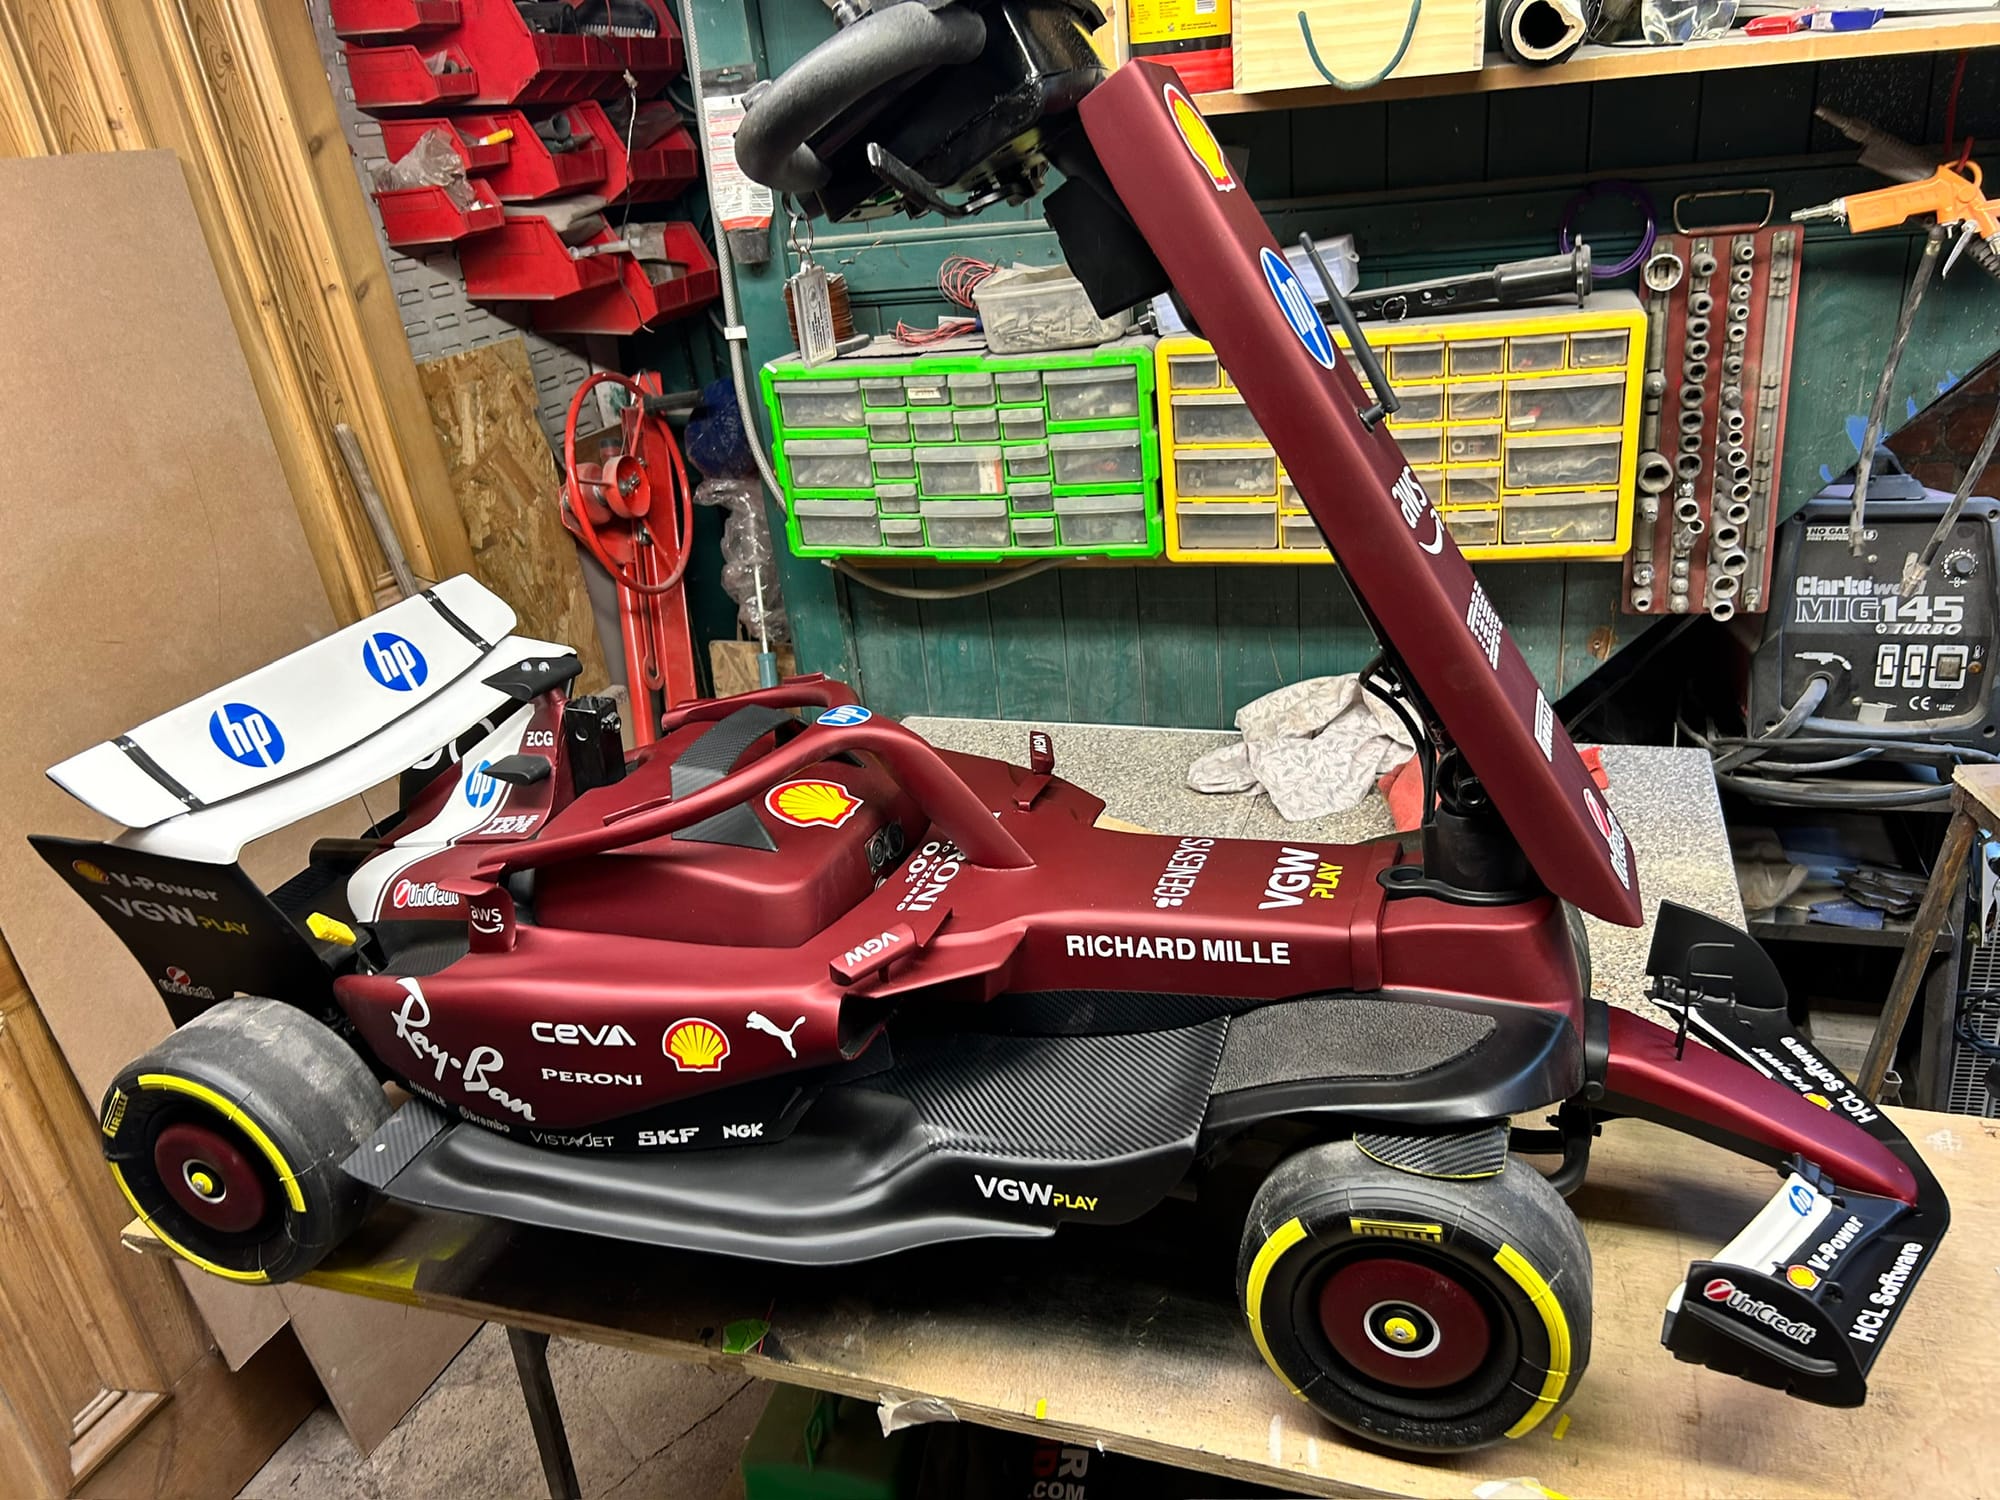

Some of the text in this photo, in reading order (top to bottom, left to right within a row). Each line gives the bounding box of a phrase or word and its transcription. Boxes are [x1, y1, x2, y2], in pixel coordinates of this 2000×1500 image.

[1262, 250, 1331, 366] hp
[1391, 465, 1428, 529] aws
[1828, 527, 1849, 535] GAS
[1796, 576, 1873, 596] Clarke
[1890, 623, 1963, 635] TURBO
[364, 633, 419, 690] hp
[215, 703, 277, 767] hp
[526, 731, 554, 746] ZCG
[1032, 734, 1047, 754] VGW
[469, 765, 492, 808] hp
[479, 815, 539, 835] IBM
[1152, 837, 1216, 899] GENESYS
[1257, 846, 1344, 910] VGW PLAY
[110, 872, 219, 902] V-Power
[100, 894, 199, 927] VGW
[471, 906, 503, 923] aws
[844, 931, 900, 967] VGW
[1065, 935, 1291, 965] RICHARD MILLE
[391, 976, 536, 1122] Ray-Ban
[541, 1068, 643, 1086] PERONI
[1780, 1036, 1878, 1124] HCL Software
[469, 1112, 511, 1133] brembo
[638, 1127, 700, 1147] SKF
[722, 1122, 764, 1140] NGK
[974, 1174, 1099, 1212] VGW PLAY
[1806, 1215, 1864, 1272] V-Power
[1848, 1241, 1924, 1344] HCL Software
[1727, 1289, 1817, 1346] UniCredit
